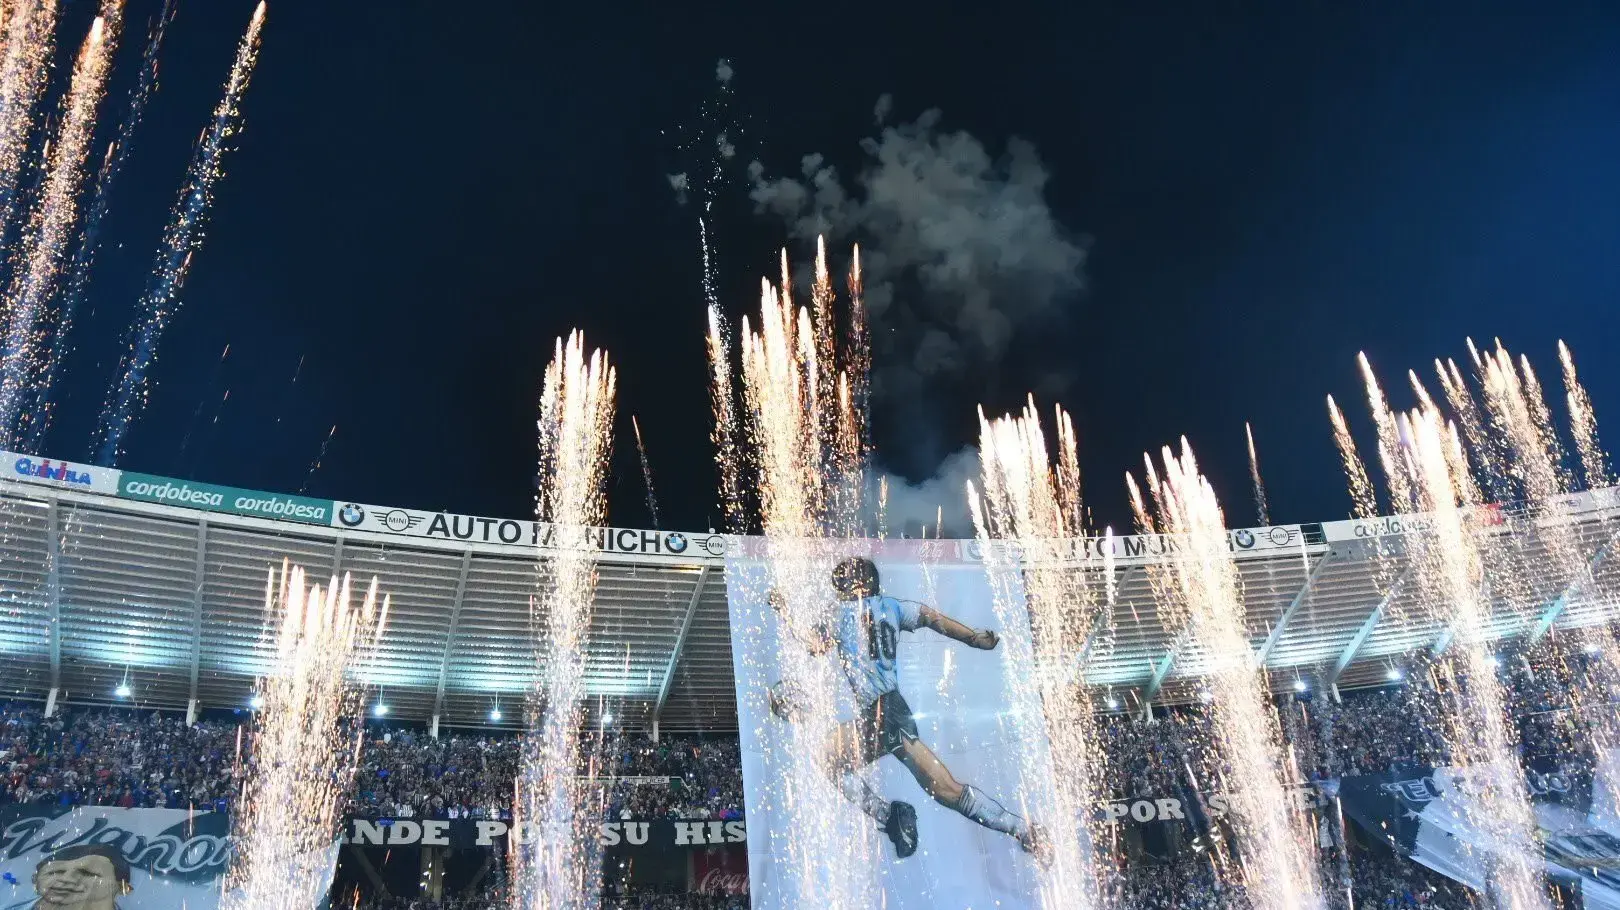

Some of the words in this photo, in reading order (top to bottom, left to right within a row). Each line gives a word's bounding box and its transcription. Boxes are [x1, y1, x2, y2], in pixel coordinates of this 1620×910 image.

[126, 481, 224, 506] cordobesa
[234, 496, 325, 519] cordobesa
[388, 516, 407, 525] MINI
[427, 513, 522, 544] AUTO
[532, 522, 661, 553] MNICH
[708, 541, 724, 549] MIN
[862, 609, 897, 661] 10
[1105, 798, 1186, 825] POR
[340, 819, 450, 846] NDE
[600, 820, 650, 846] SU
[674, 820, 748, 846] HIS
